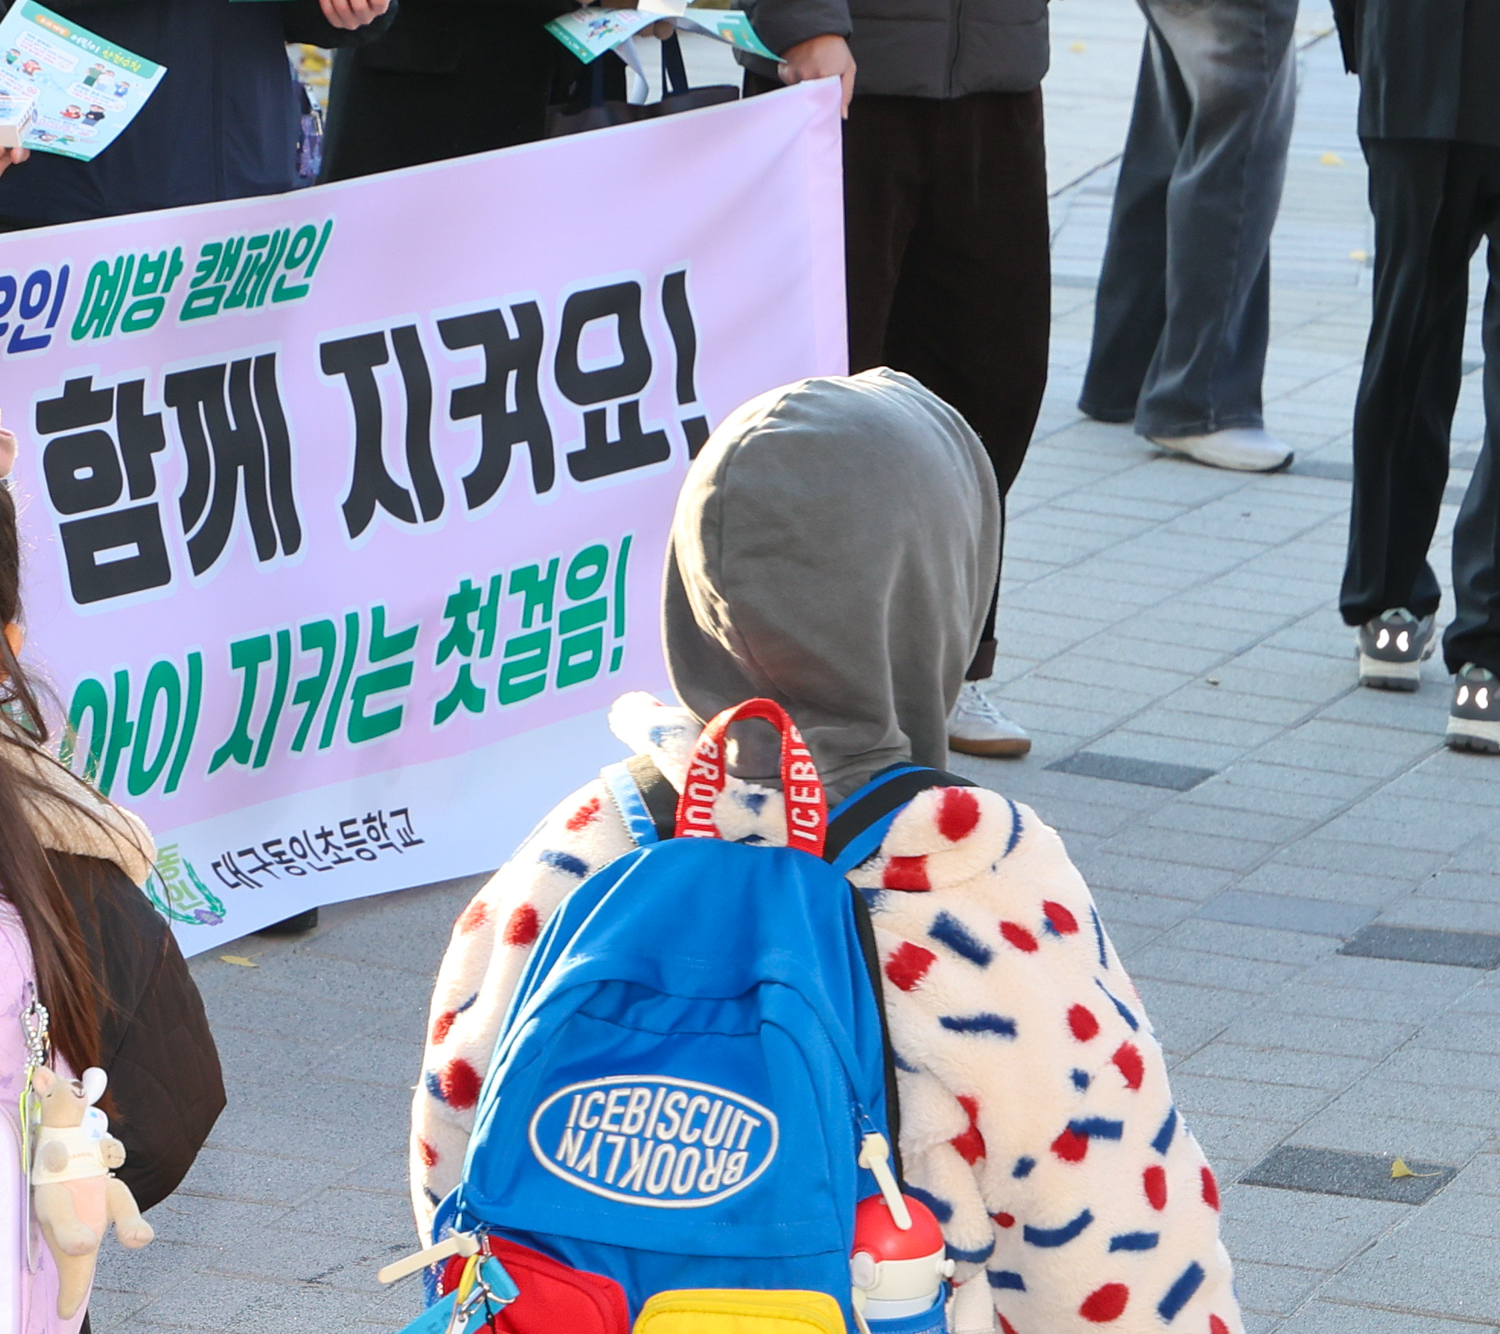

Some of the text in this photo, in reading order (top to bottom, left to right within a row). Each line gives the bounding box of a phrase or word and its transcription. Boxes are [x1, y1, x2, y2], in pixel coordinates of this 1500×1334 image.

[71, 245, 185, 341] 예방
[179, 219, 333, 322] 캠페인
[34, 350, 303, 606] 함께
[319, 267, 711, 542] 지켜요!
[207, 604, 418, 775] 지키는
[433, 534, 633, 726] 첫걸음!
[157, 842, 205, 911] 동인
[211, 807, 425, 890] 대구동인초등학교
[566, 1087, 761, 1150] ICEBISCUIT
[555, 1127, 749, 1195] BROOKLYN
